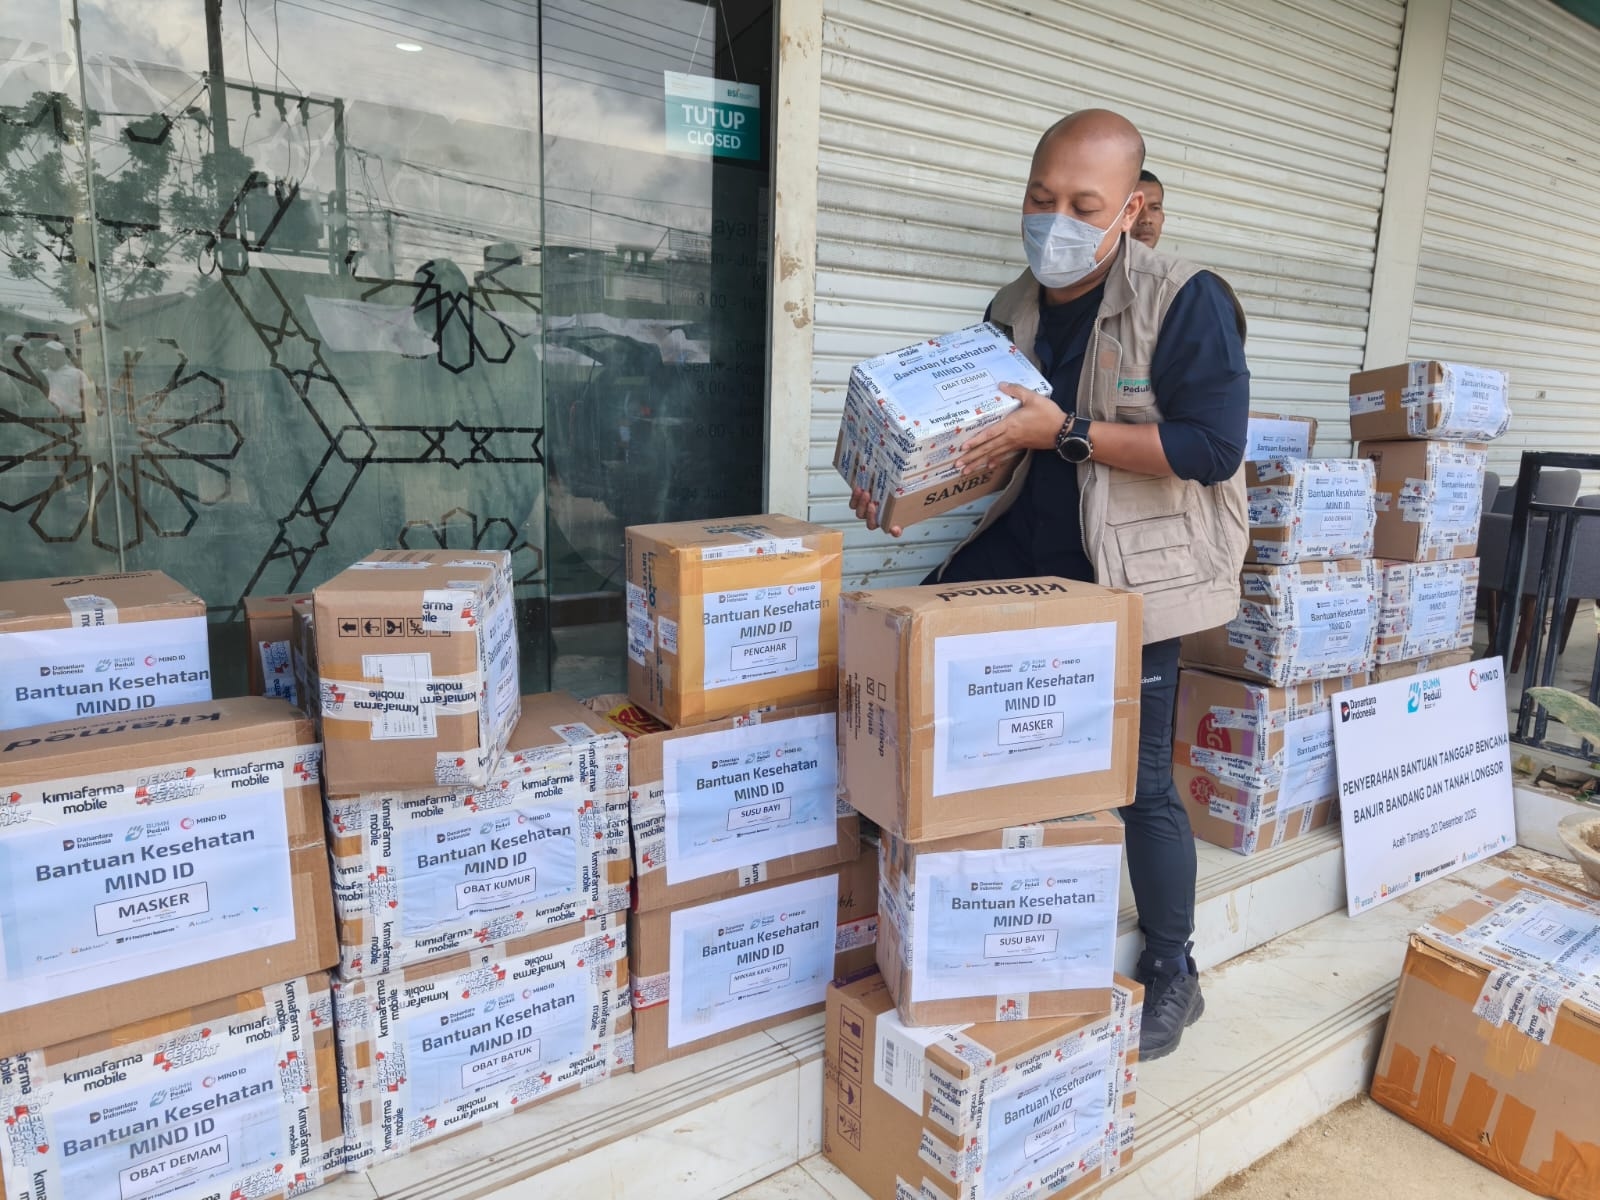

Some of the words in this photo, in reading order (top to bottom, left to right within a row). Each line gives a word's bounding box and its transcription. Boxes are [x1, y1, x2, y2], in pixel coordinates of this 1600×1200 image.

[681, 103, 745, 130] TUTUP
[688, 130, 741, 149] CLOSED
[893, 360, 940, 382] Bantuan
[939, 343, 998, 367] Kesehatan
[931, 366, 962, 380] MIND
[963, 361, 976, 373] ID
[941, 380, 959, 392] OBAT
[960, 371, 988, 386] DEMAM
[929, 408, 970, 425] kimiafarma
[923, 470, 993, 506] SANBE
[1308, 489, 1335, 498] Bantuan
[1335, 488, 1366, 498] Kesehatan
[936, 583, 1068, 602] kifamed
[703, 610, 760, 625] Bantuan
[763, 598, 830, 617] Kesehatan
[1311, 611, 1337, 622] Bantuan
[1337, 608, 1366, 619] Kesehatan
[740, 622, 776, 640] MIND
[779, 620, 793, 633] ID
[743, 642, 787, 657] PENCAHAR
[16, 681, 103, 702] Bantuan
[109, 669, 209, 691] Kesehatan
[968, 680, 1023, 697] Bantuan
[1026, 673, 1095, 691] Kesehatan
[1422, 678, 1441, 690] BUMN
[1479, 671, 1492, 683] MIND
[1493, 669, 1499, 680] ID
[369, 689, 405, 700] mobile
[426, 682, 463, 692] mobile
[1423, 690, 1442, 702] Peduli
[76, 696, 131, 716] MIND
[137, 694, 155, 709] ID
[354, 700, 419, 716] kimiafarma
[1005, 696, 1040, 712] MIND
[1043, 694, 1056, 708] ID
[1350, 696, 1377, 709] Danantara
[1351, 707, 1377, 721] Indonesia
[1011, 719, 1054, 735] MASKER
[213, 760, 285, 779] kimiafarma
[696, 772, 751, 791] Bantuan
[753, 758, 818, 780] Kesehatan
[1343, 767, 1399, 796] PENYERAHAN
[1401, 756, 1438, 778] BANTUAN
[1440, 745, 1474, 766] TANGGAP
[1475, 734, 1508, 754] BENCANA
[231, 773, 270, 789] mobile
[522, 774, 574, 790] kimiafarma
[734, 784, 769, 802] MIND
[772, 781, 785, 795] ID
[1354, 799, 1384, 823] BANJIR
[1386, 790, 1425, 812] BANDANG
[1426, 785, 1443, 798] DAN
[1444, 774, 1469, 792] TANAH
[1471, 760, 1504, 785] LONGSOR
[43, 782, 125, 804] kimiafarma
[535, 786, 563, 799] mobile
[63, 798, 107, 814] mobile
[740, 807, 761, 818] SUSU
[763, 803, 781, 813] BAYI
[196, 815, 217, 824] MIND
[218, 813, 227, 821] ID
[77, 832, 113, 843] Danantara
[1392, 835, 1406, 849] Aceh
[1431, 823, 1438, 834] 20
[1438, 814, 1463, 831] Desember
[77, 838, 112, 849] Indonesia
[417, 842, 486, 869] Bantuan
[490, 825, 571, 852] Kesehatan
[35, 853, 135, 882] Bantuan
[141, 828, 255, 861] Kesehatan
[464, 856, 508, 876] MIND
[513, 851, 527, 866] ID
[105, 867, 167, 894] MIND
[173, 861, 195, 880] ID
[463, 881, 491, 895] OBAT
[493, 874, 531, 893] KUMUR
[118, 892, 190, 919] MASKER
[951, 896, 1016, 911] Bantuan
[1019, 893, 1096, 909] Kesehatan
[993, 914, 1033, 928] MIND
[1037, 912, 1053, 925] ID
[702, 936, 754, 958] Bantuan
[757, 920, 820, 944] Kesehatan
[999, 935, 1023, 946] SUSU
[1025, 933, 1045, 944] BAYI
[736, 948, 770, 966] MIND
[772, 943, 785, 956] ID
[285, 981, 301, 1042] kimiafarma
[378, 979, 389, 1038] kimiafarma
[390, 988, 400, 1021] mobile
[275, 1000, 286, 1033] mobile
[422, 1021, 491, 1052] Bantuan
[495, 992, 575, 1028] Kesehatan
[470, 1030, 513, 1056] MIND
[517, 1025, 533, 1040] ID
[64, 1053, 143, 1084] kimiafarma
[472, 1058, 498, 1073] OBAT
[500, 1045, 532, 1064] BATUK
[1014, 1048, 1052, 1072] kimiafarma
[1022, 1062, 1043, 1077] mobile
[84, 1070, 127, 1092] mobile
[217, 1070, 238, 1081] MIND
[456, 1096, 486, 1112] mobile
[1004, 1092, 1050, 1125] Bantuan
[1050, 1068, 1104, 1101] Kesehatan
[63, 1117, 159, 1157] Bantuan
[164, 1079, 274, 1123] Kesehatan
[102, 1101, 138, 1114] Danantara
[103, 1107, 137, 1121] Indonesia
[443, 1100, 499, 1126] kimiafarma
[1033, 1102, 1061, 1128] MIND
[1062, 1097, 1073, 1113] ID
[129, 1124, 189, 1159] MIND
[194, 1117, 215, 1138] ID
[288, 1125, 297, 1156] mobile
[298, 1106, 311, 1165] kimiafarma
[129, 1163, 167, 1183] OBAT
[170, 1144, 222, 1169] DEMAM
[1040, 1160, 1075, 1186] kimiafarma
[1048, 1173, 1068, 1191] mobile
